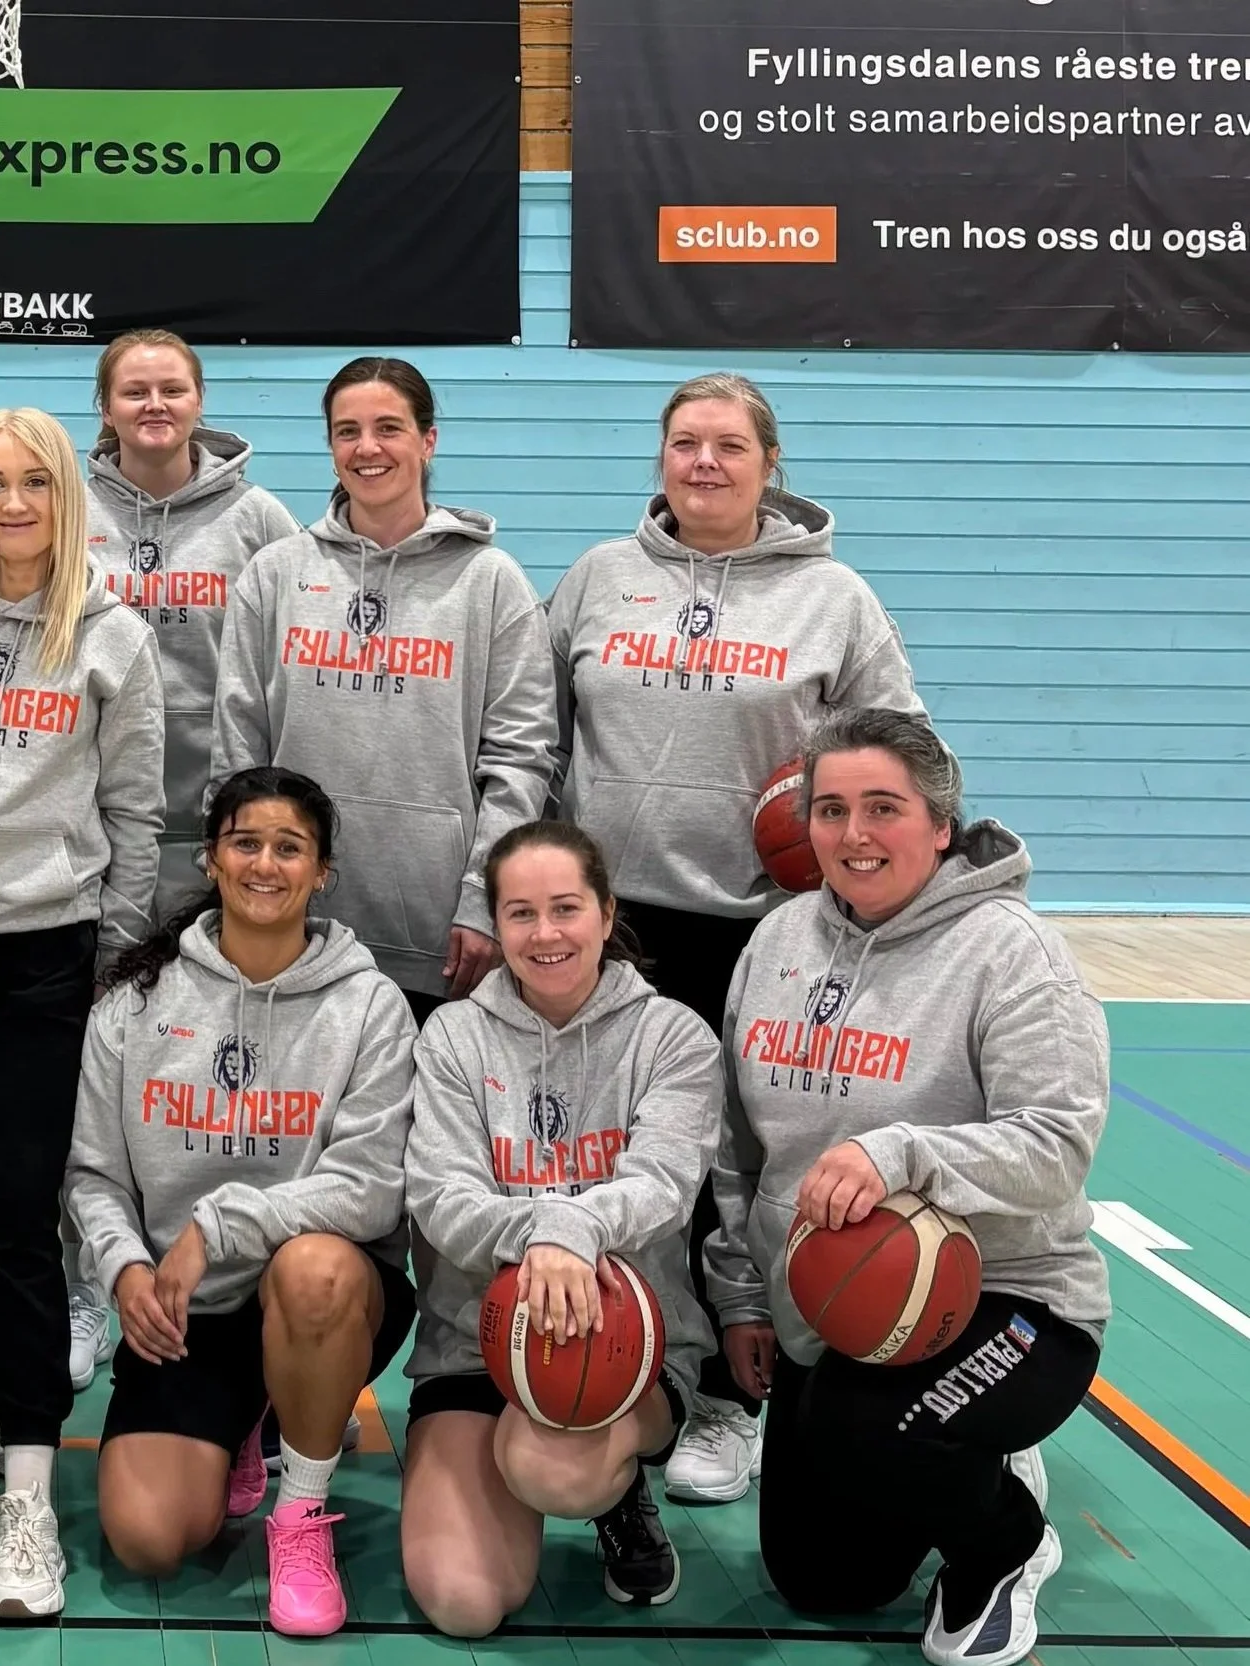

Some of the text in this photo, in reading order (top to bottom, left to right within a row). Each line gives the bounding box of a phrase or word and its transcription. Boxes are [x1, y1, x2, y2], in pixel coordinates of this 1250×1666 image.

[747, 47, 1041, 85] Fyllingsdalens
[1054, 47, 1177, 80] råeste
[698, 107, 743, 140] og
[756, 104, 837, 134] stolt
[848, 103, 1202, 141] samarbeidspartner
[675, 220, 821, 249] sclub.no
[872, 220, 1247, 258] Tren hos oss du også
[281, 626, 455, 681] FYLLINGEN
[315, 668, 405, 694] LIONS
[641, 669, 735, 692] LIONS
[184, 1131, 280, 1156] LIONS
[872, 1323, 914, 1362] ERIKA
